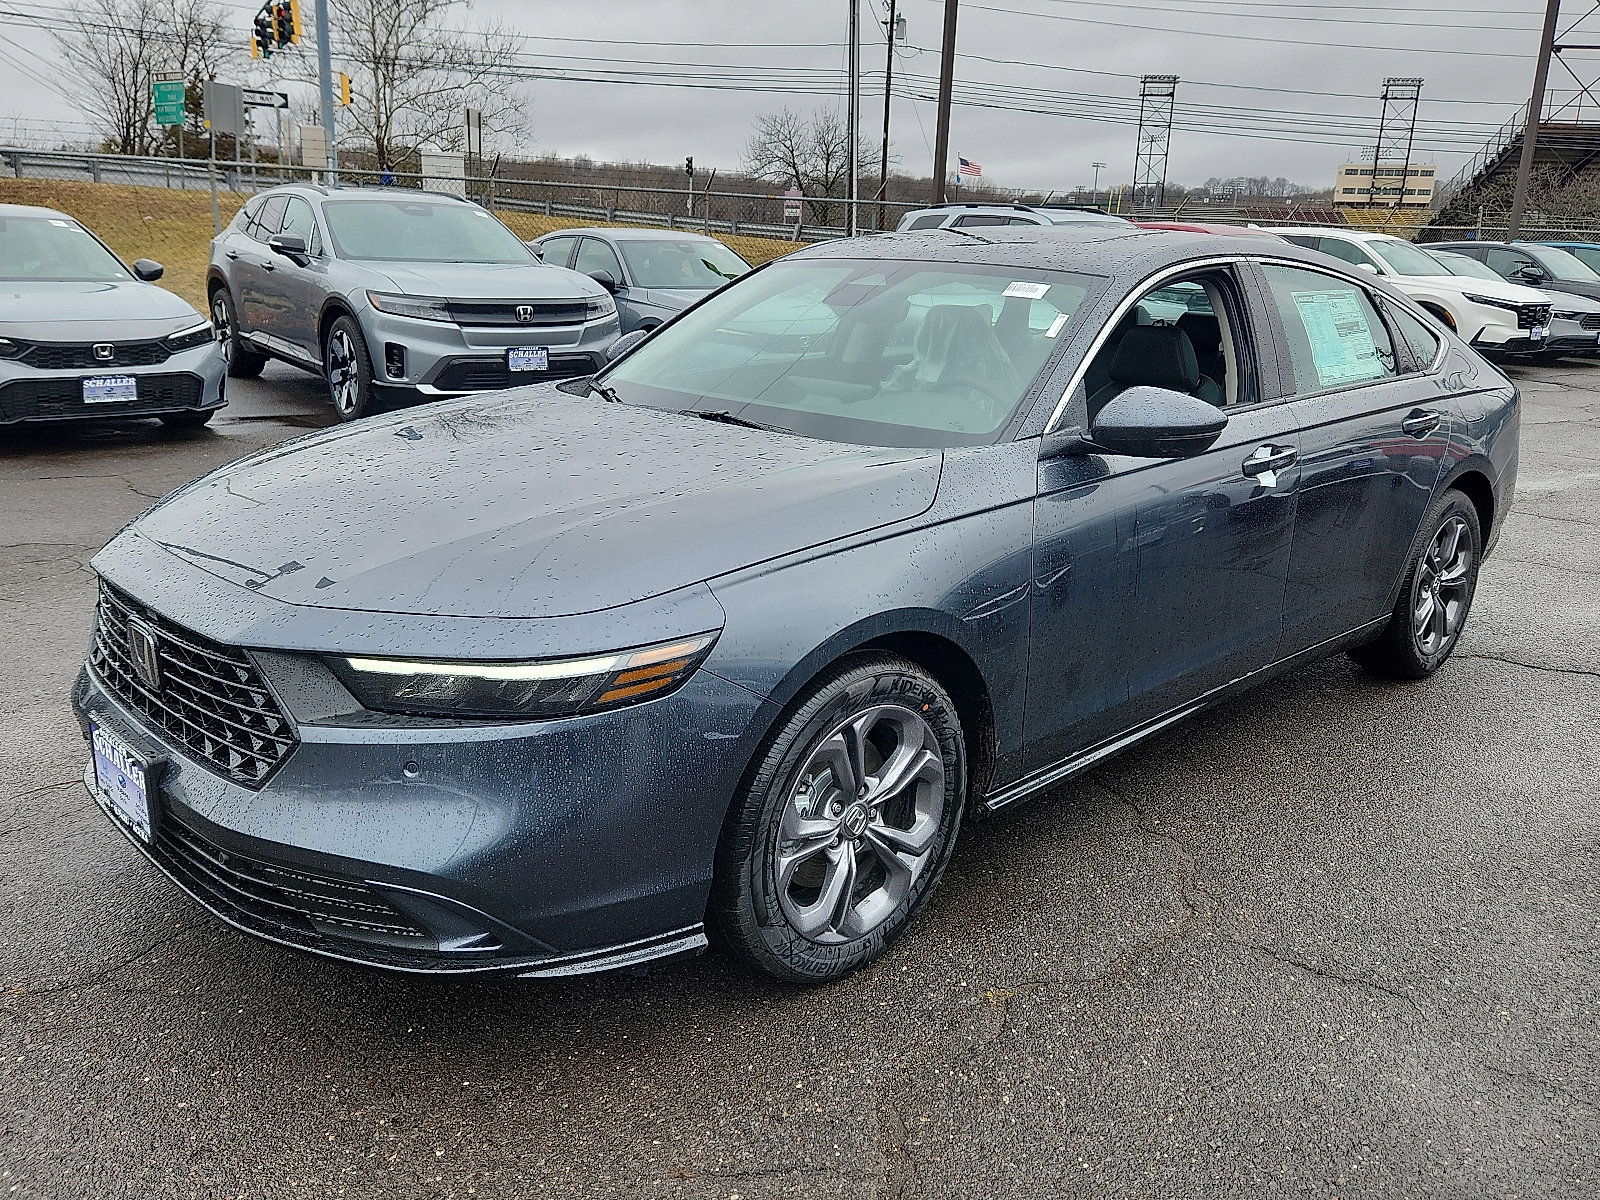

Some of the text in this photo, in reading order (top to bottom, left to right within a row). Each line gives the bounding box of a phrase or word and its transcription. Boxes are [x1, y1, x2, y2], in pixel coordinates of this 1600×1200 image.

[509, 350, 547, 359] SCHALLER
[83, 378, 137, 388] SCHALLER
[92, 729, 147, 796] SCHALLER
